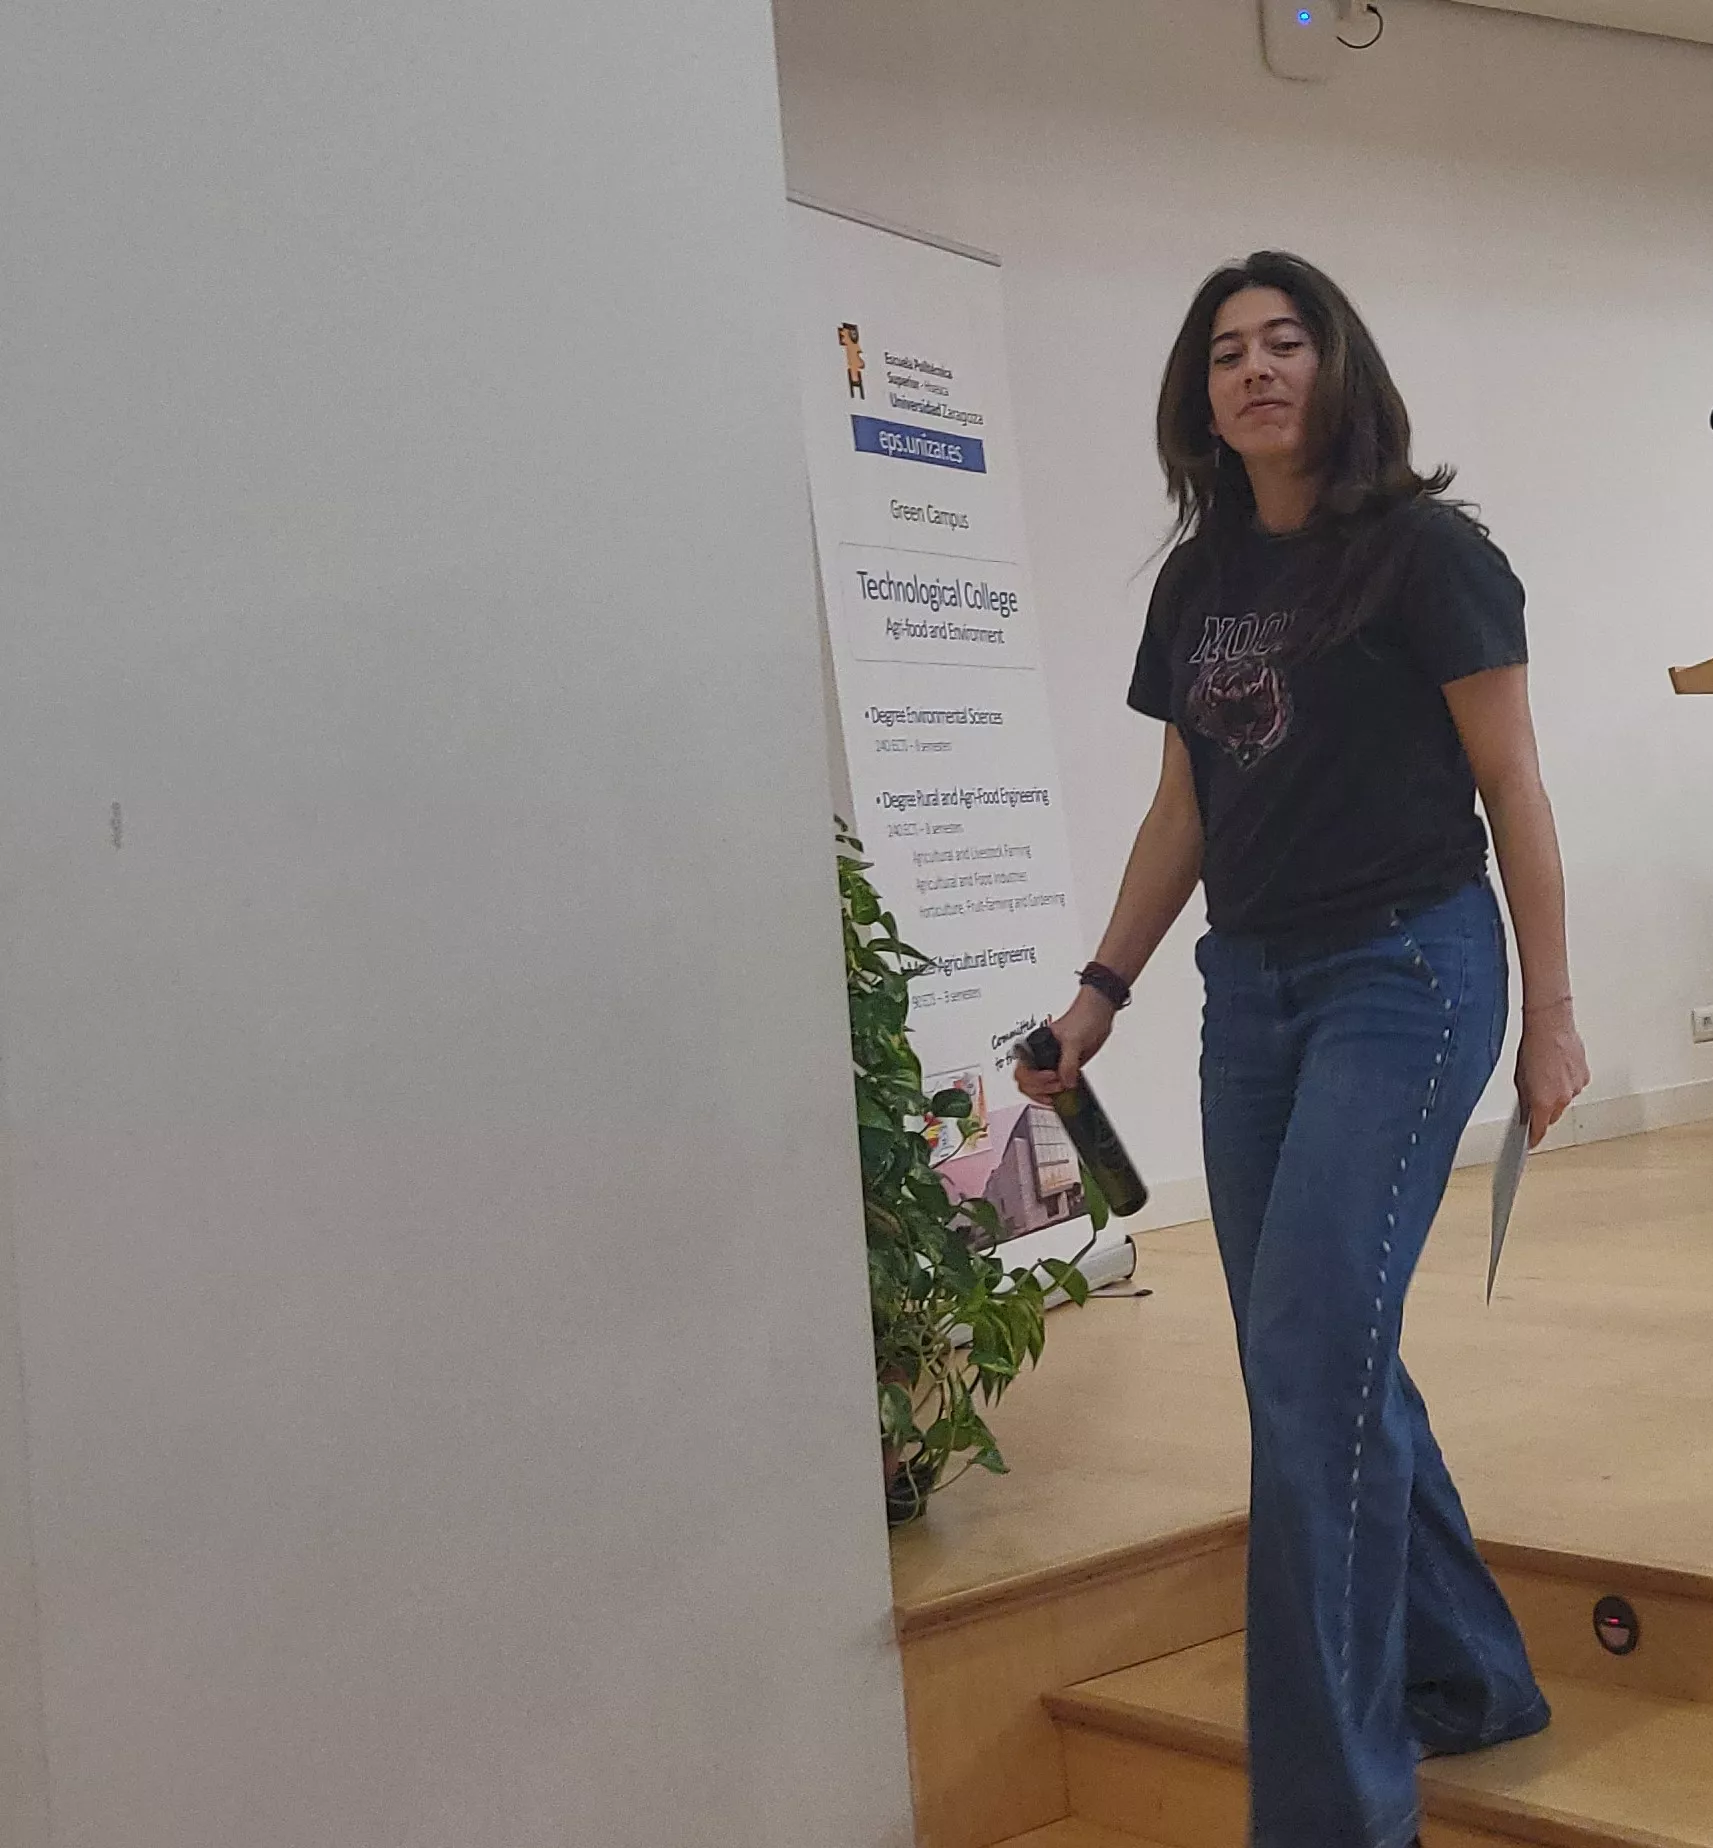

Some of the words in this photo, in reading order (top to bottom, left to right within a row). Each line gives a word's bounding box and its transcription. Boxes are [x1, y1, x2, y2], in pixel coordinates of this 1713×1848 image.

[890, 392, 941, 417] Universidad
[942, 403, 984, 427] Zaragoza
[878, 430, 963, 464] eps.unizar.es
[890, 499, 925, 523] Green
[926, 503, 969, 532] Campus
[856, 569, 962, 612] Technological
[964, 580, 1018, 618] College
[929, 621, 948, 640] and
[949, 622, 1005, 645] Environment
[1188, 608, 1297, 664] NOC
[870, 706, 906, 728] Degree
[906, 705, 967, 725] Environmental
[968, 707, 1003, 726] Sciences
[881, 791, 916, 812] Degree
[916, 789, 940, 806] Rural
[940, 786, 958, 806] and
[1000, 785, 1050, 808] Engineering
[987, 945, 1037, 969] Engineering
